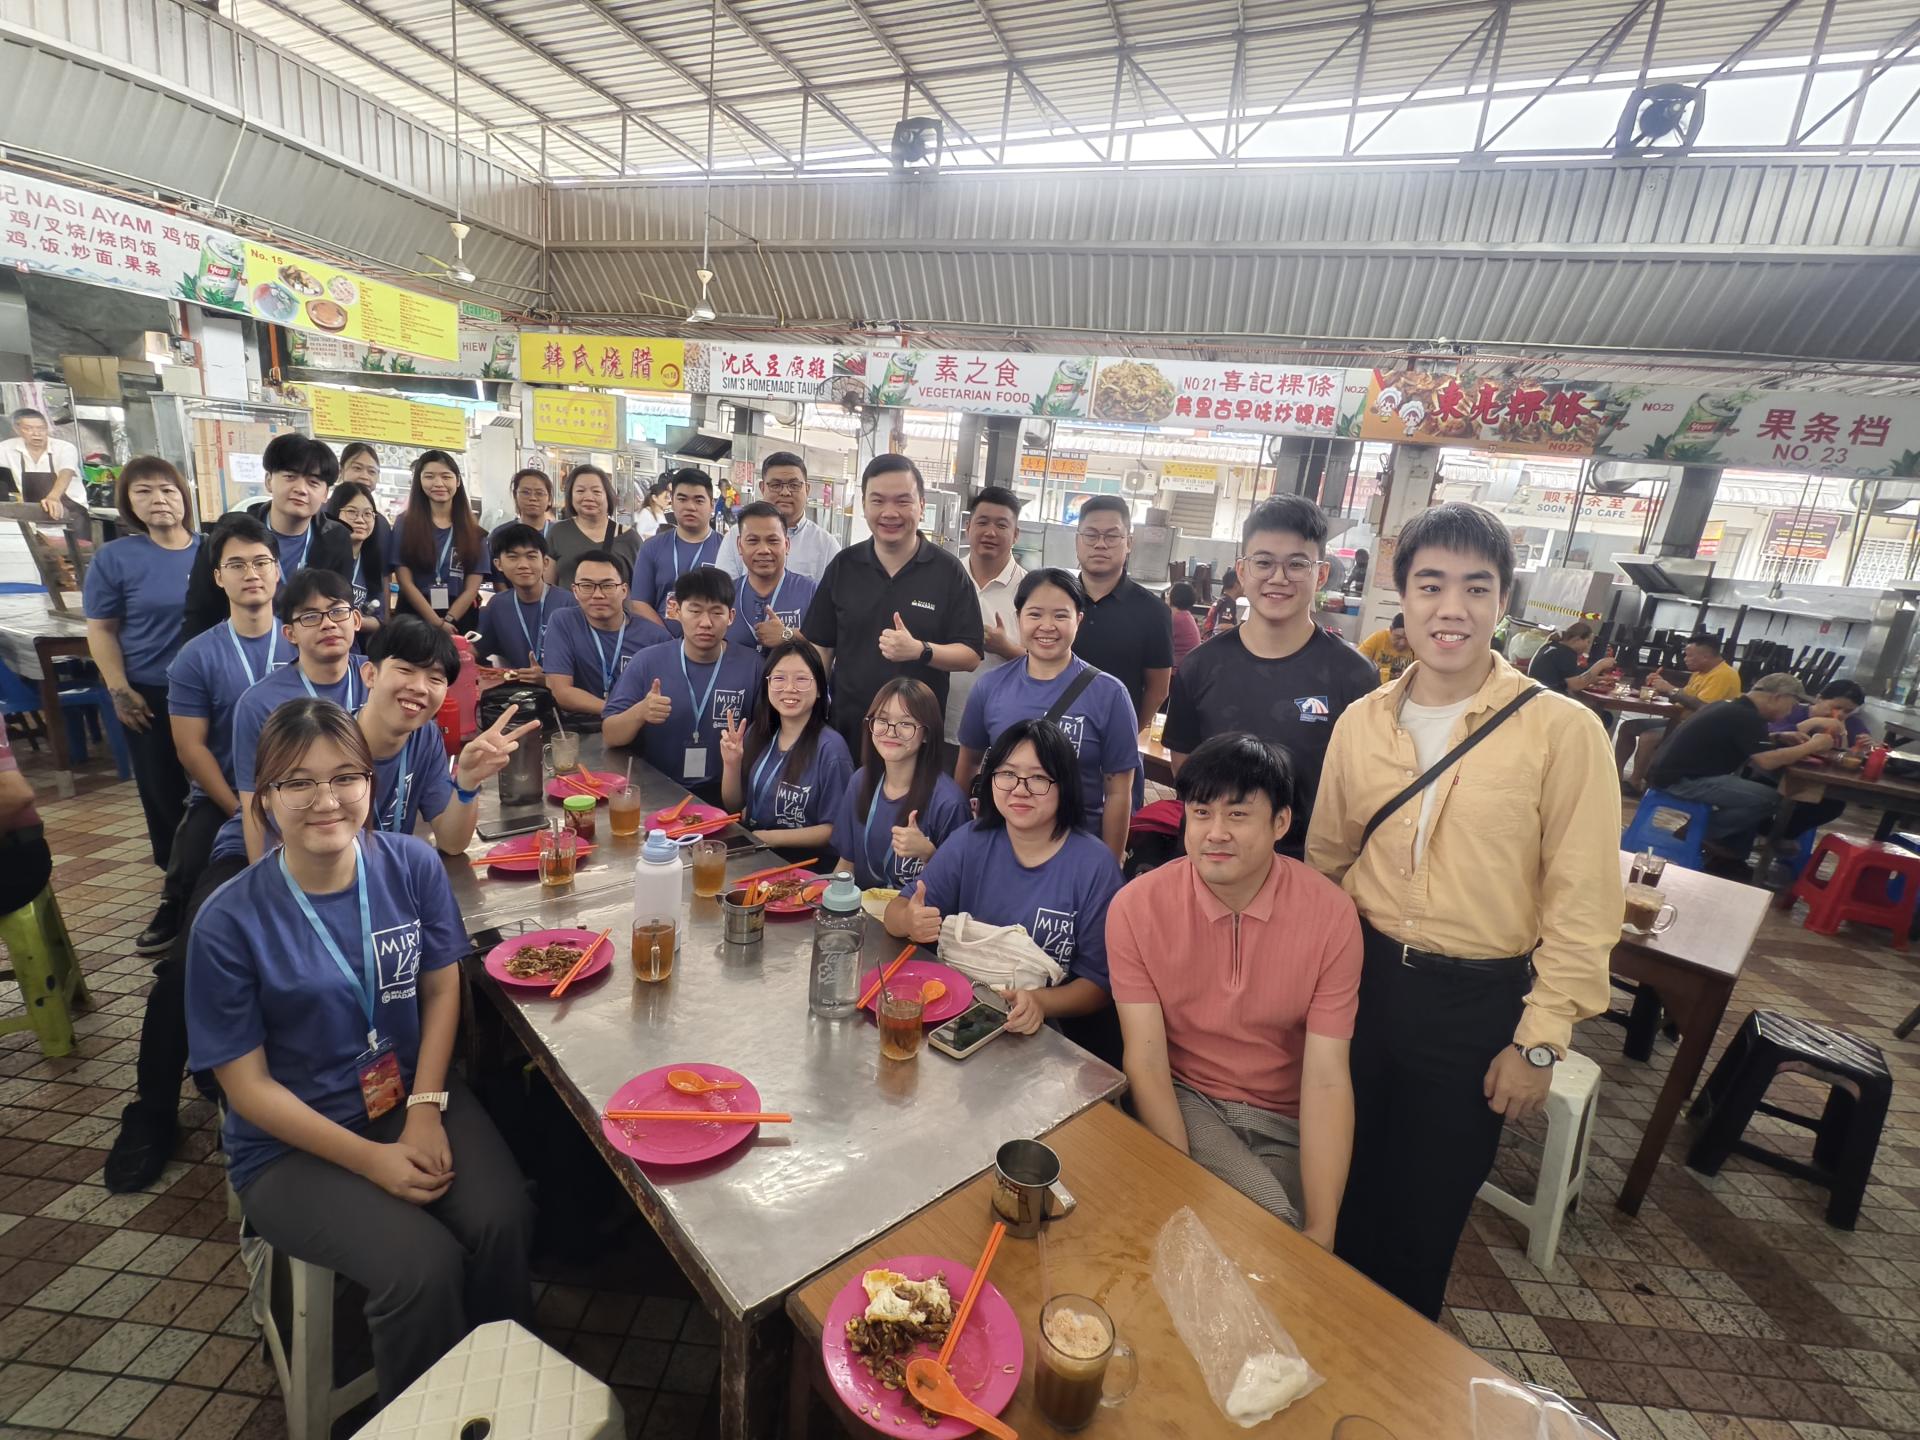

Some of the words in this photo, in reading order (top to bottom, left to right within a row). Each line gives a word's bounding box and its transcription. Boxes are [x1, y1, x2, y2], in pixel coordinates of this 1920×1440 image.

[26, 189, 85, 217] NASI
[92, 206, 152, 234] AYAM
[162, 225, 201, 251] 鸡饭
[271, 255, 284, 265] 15
[541, 340, 654, 381] 韩氏烧腊
[934, 355, 1020, 388] 素之食
[722, 377, 745, 391] SIM'S
[747, 378, 795, 394] HOMEMADE
[1219, 370, 1336, 397] 喜記粿條
[1345, 385, 1367, 394] NO.22
[919, 387, 992, 401] VEGETARIAN
[996, 391, 1030, 404] FOOD
[1757, 408, 1893, 448] 果条档
[1548, 442, 1583, 453] NO22
[1772, 444, 1812, 461] NO.
[1820, 447, 1848, 464] 23
[1537, 504, 1566, 513] SOON
[1597, 509, 1626, 518] CAFE
[716, 694, 740, 704] MIRI
[1059, 721, 1077, 735] IRI
[778, 787, 804, 804] MIRI
[783, 799, 804, 820] Kita
[1038, 916, 1074, 935] MIRI
[381, 929, 420, 956] MIRI
[1041, 931, 1075, 963] Kita
